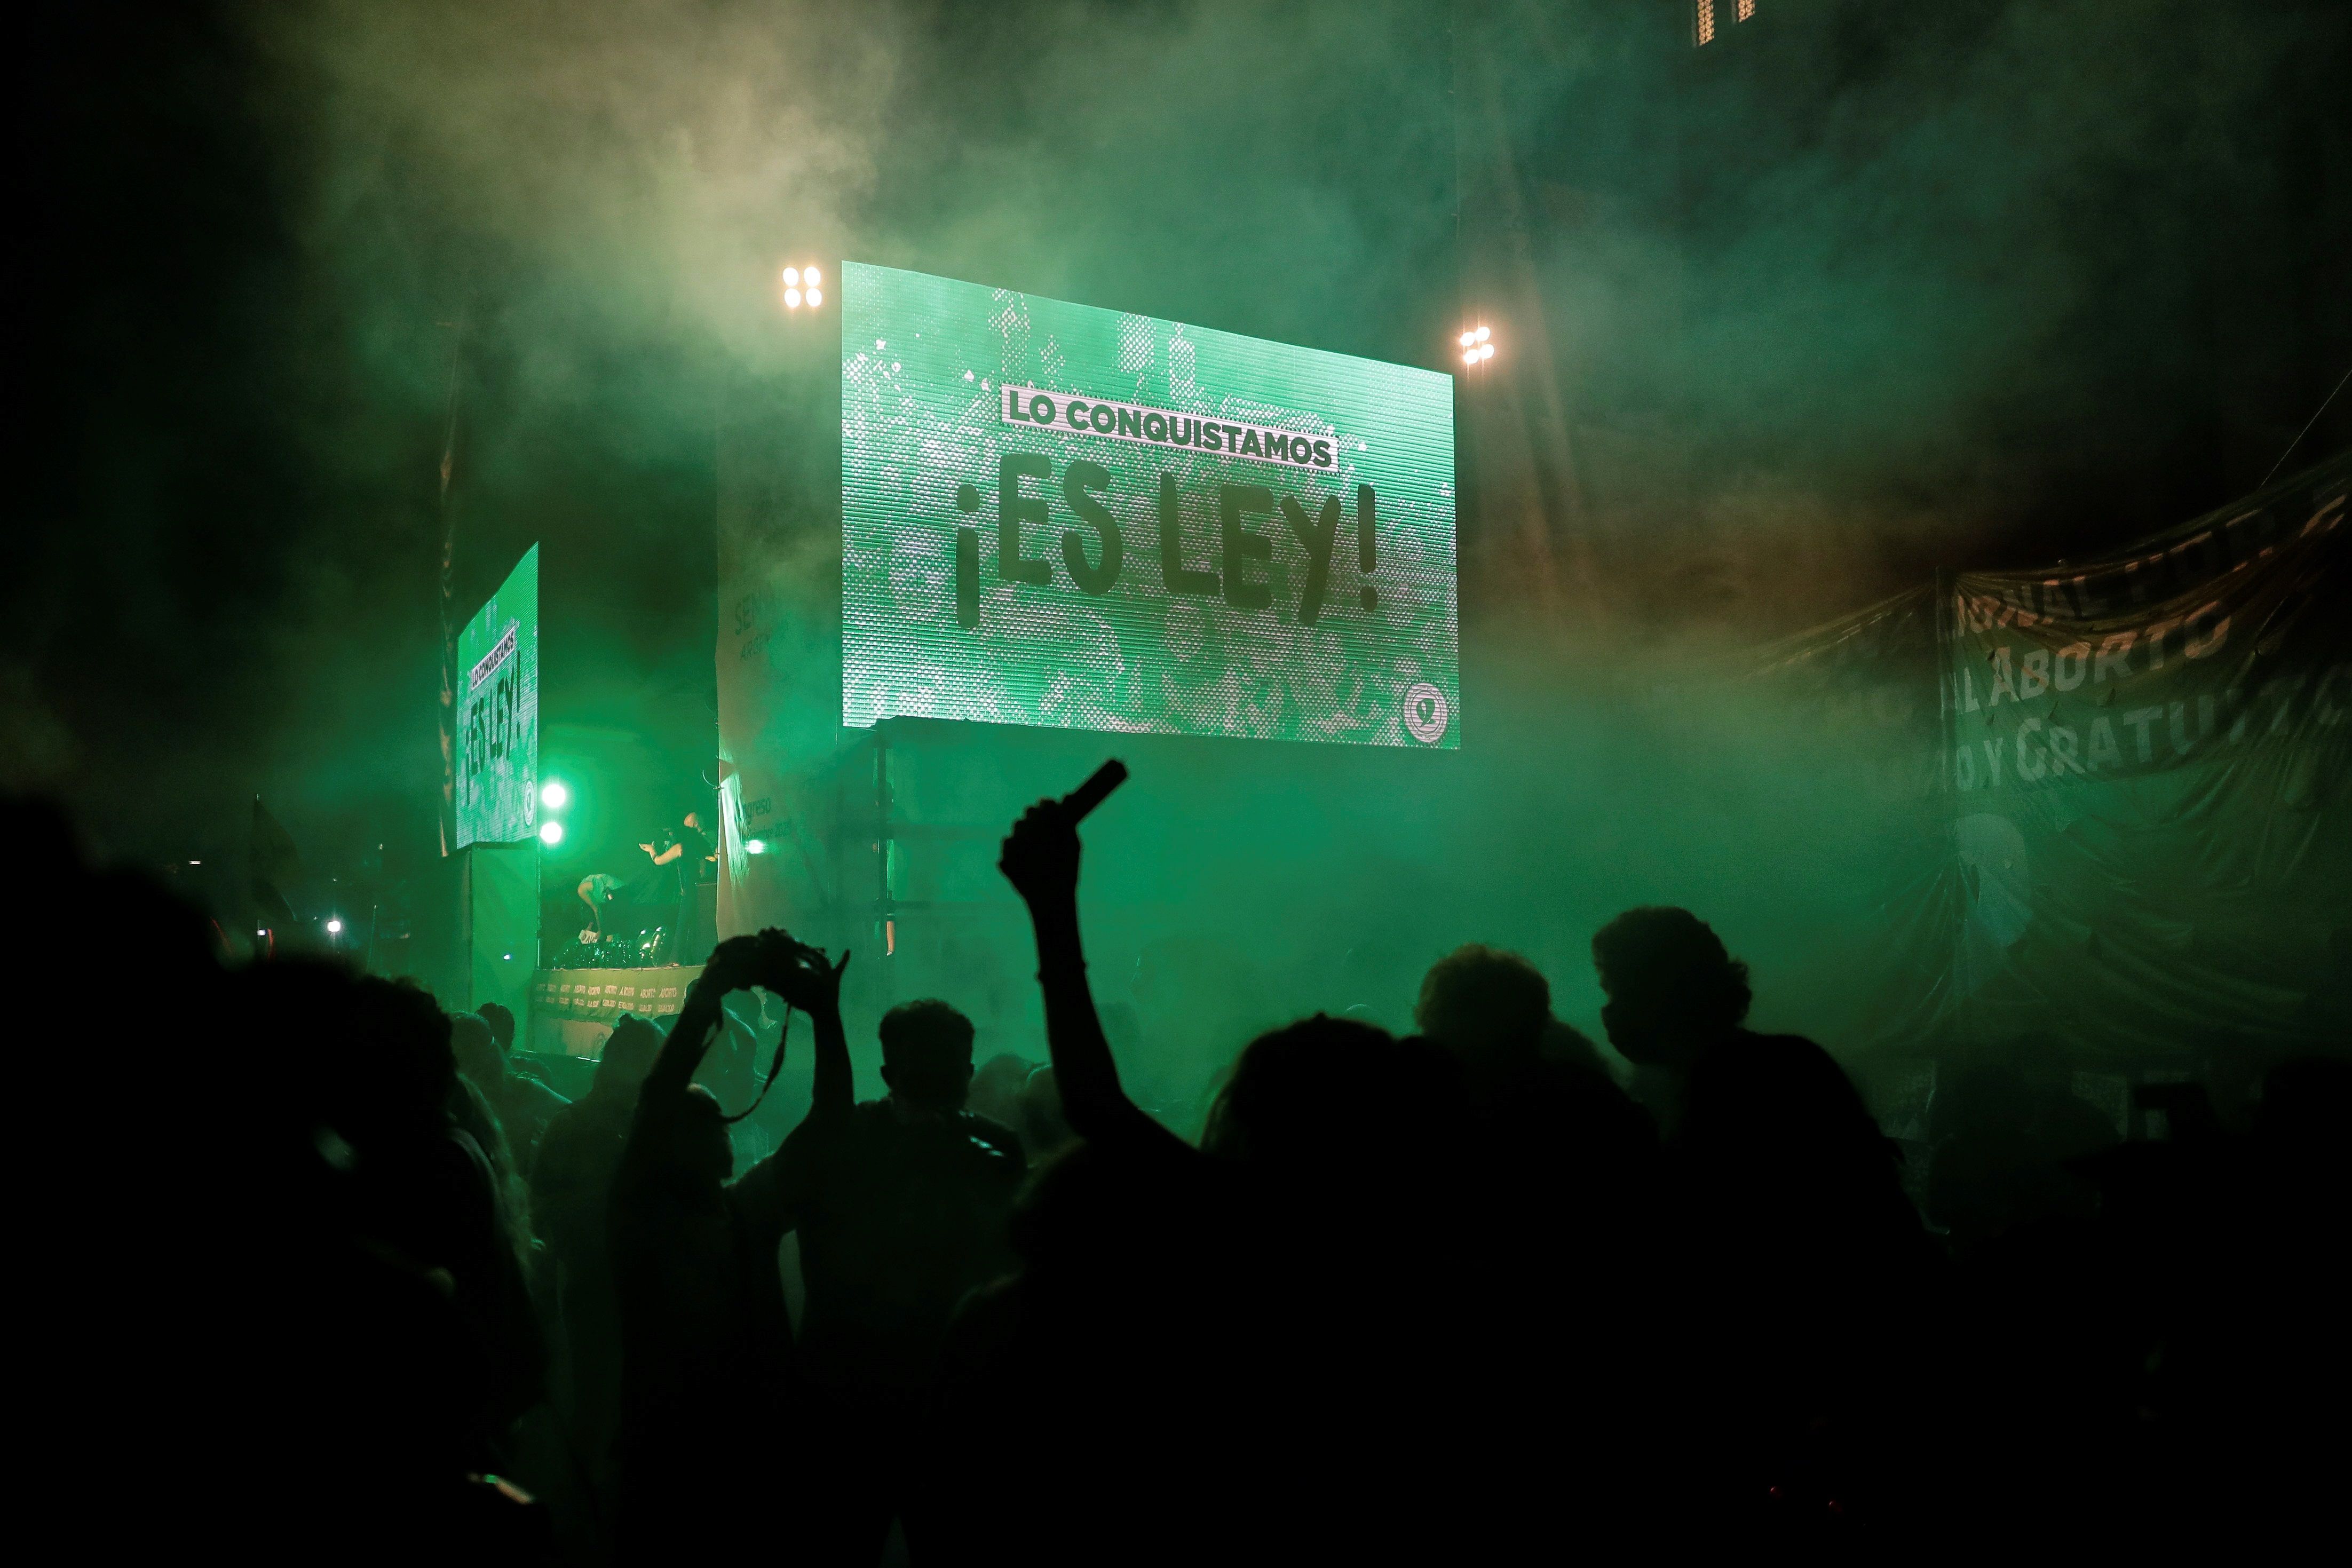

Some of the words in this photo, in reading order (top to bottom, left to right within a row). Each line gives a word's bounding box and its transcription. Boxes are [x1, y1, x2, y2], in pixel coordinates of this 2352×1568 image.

[1009, 391, 1056, 424] LO
[1066, 401, 1333, 467] CONQUISTAMOS
[955, 453, 1122, 630] ¡ES
[1160, 471, 1378, 628] LEY!
[479, 630, 514, 682] CONQUISTAMOS
